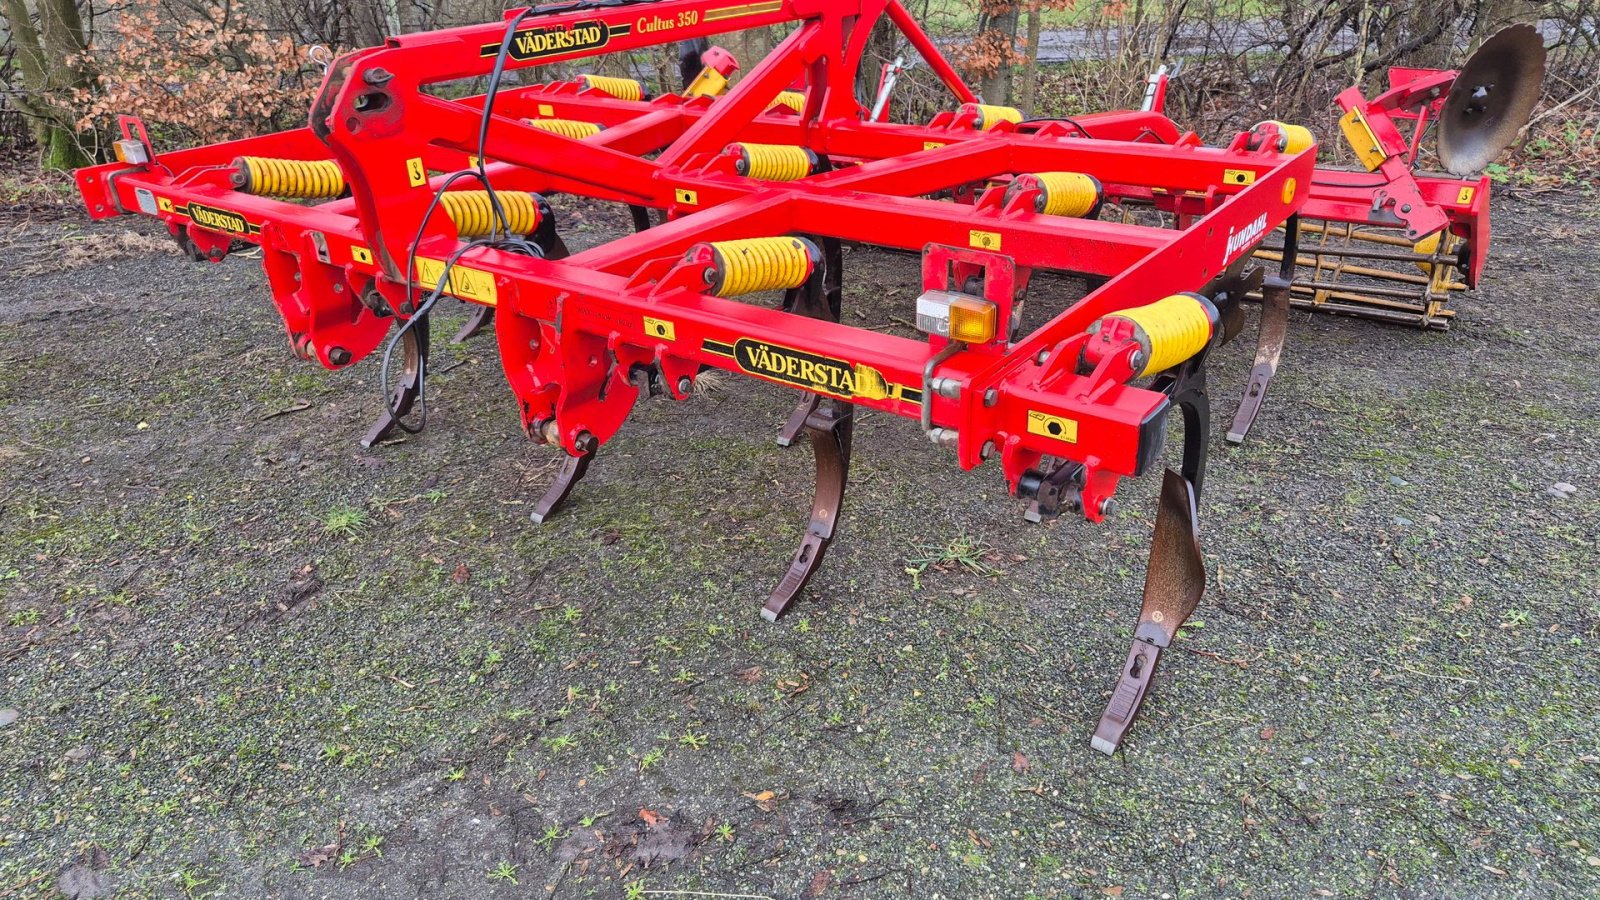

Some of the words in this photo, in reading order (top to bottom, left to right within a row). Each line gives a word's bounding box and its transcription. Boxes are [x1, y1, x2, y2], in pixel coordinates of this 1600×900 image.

[515, 26, 601, 54] VÄDERSTAD
[636, 15, 674, 33] Cultus
[677, 10, 699, 26] 350
[192, 205, 245, 232] VÄDERSTAD
